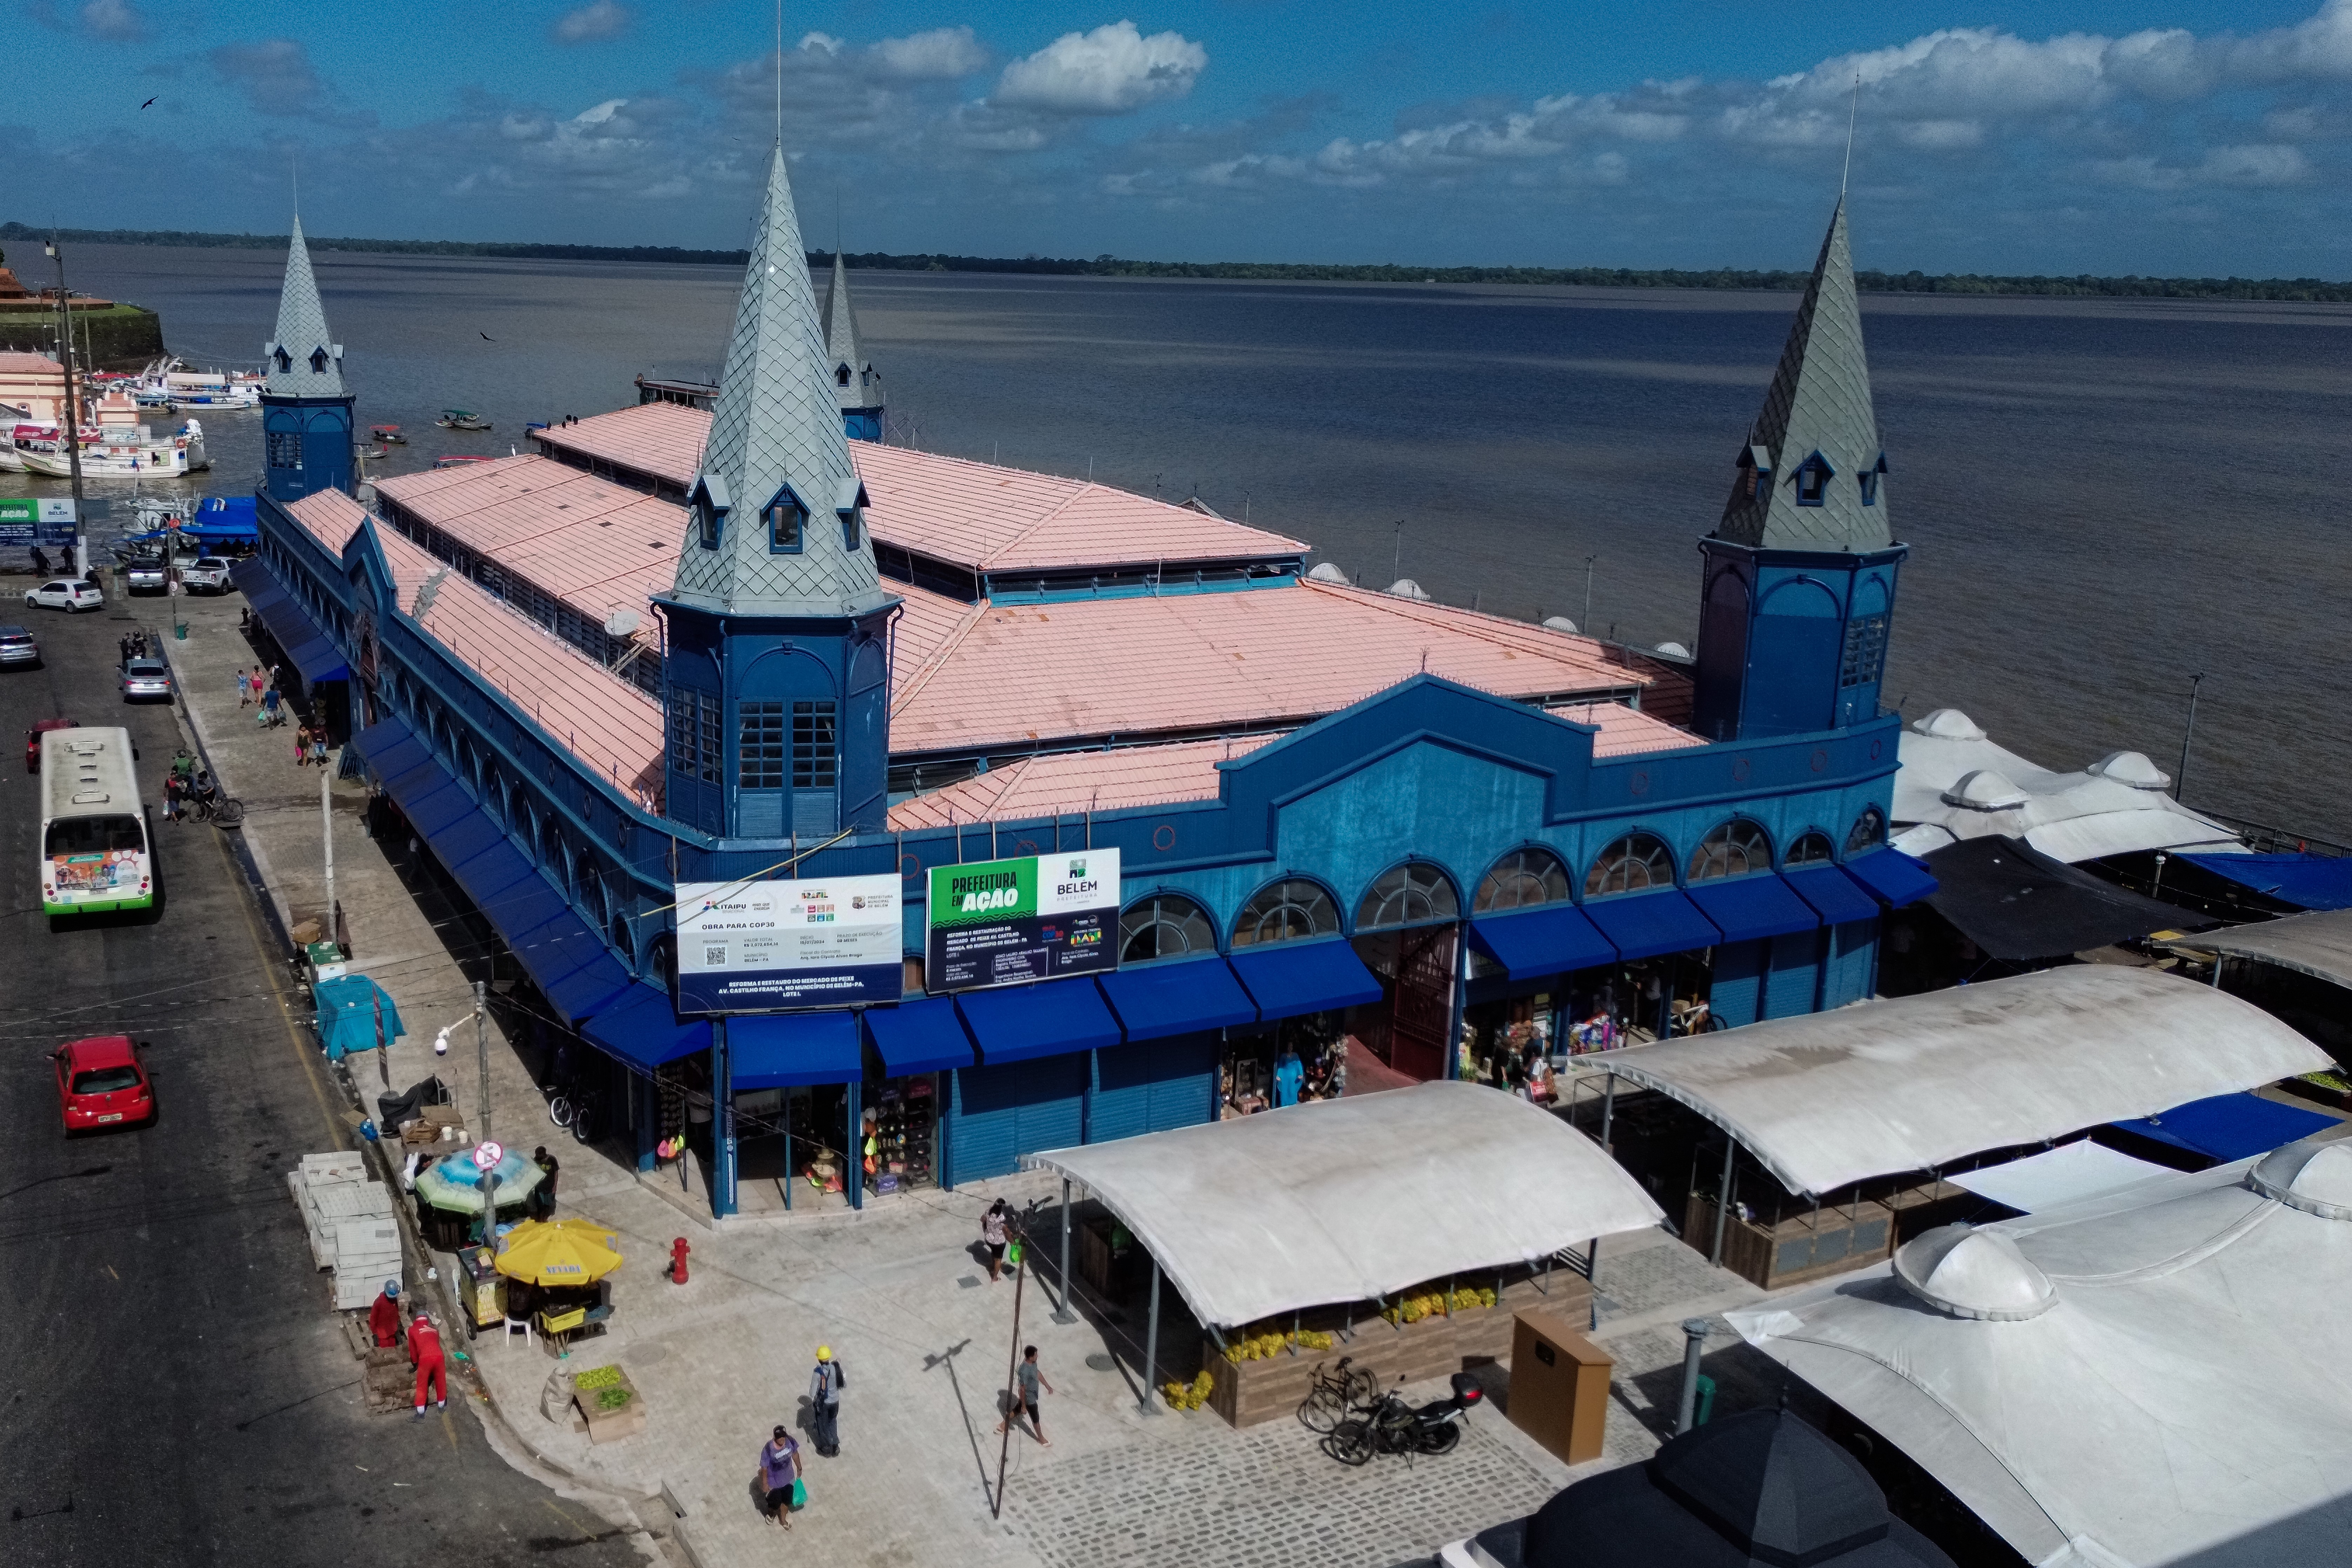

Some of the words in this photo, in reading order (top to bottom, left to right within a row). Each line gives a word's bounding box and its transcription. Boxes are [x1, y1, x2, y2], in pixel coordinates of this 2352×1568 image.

[952, 871, 1017, 893] PREFEITURA
[1058, 879, 1097, 895] BELÉM
[951, 895, 963, 907] EM
[961, 888, 1018, 912] AÇÃO
[1057, 893, 1097, 901] PREFEITURA
